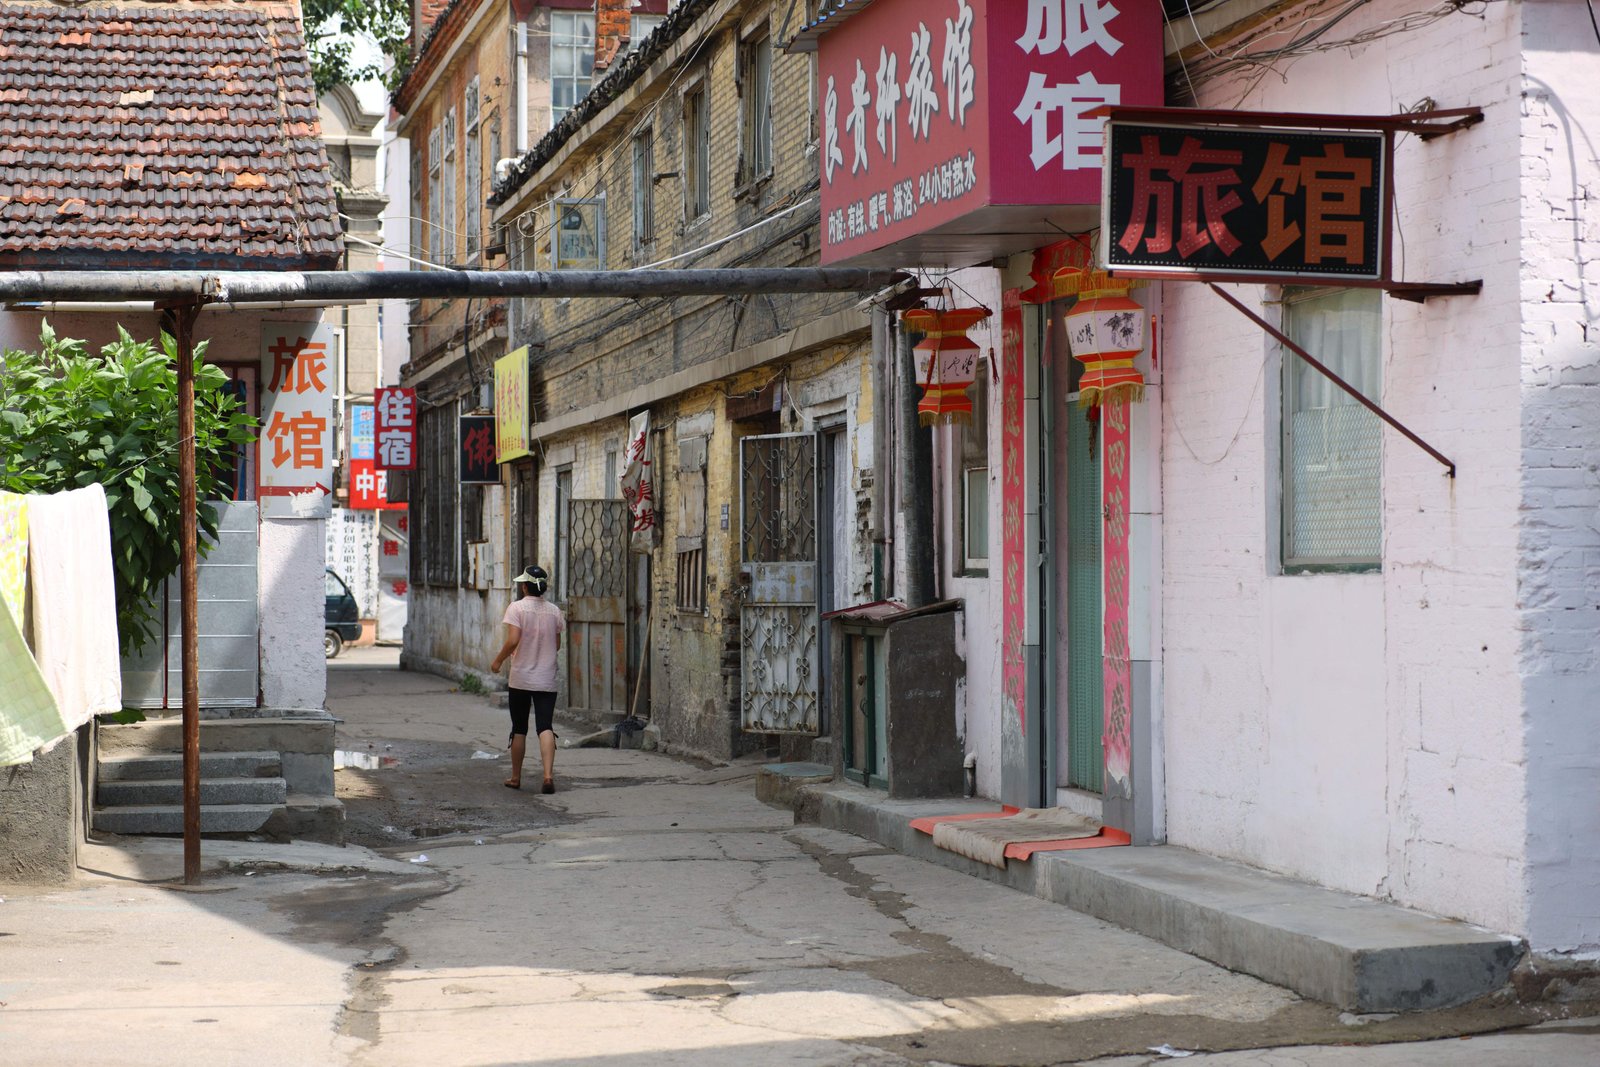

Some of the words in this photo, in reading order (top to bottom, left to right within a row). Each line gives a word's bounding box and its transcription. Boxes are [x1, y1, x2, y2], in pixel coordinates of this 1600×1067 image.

[1118, 135, 1373, 265] 旅馆
[267, 336, 328, 470] 旅馆
[378, 389, 413, 466] 住宿
